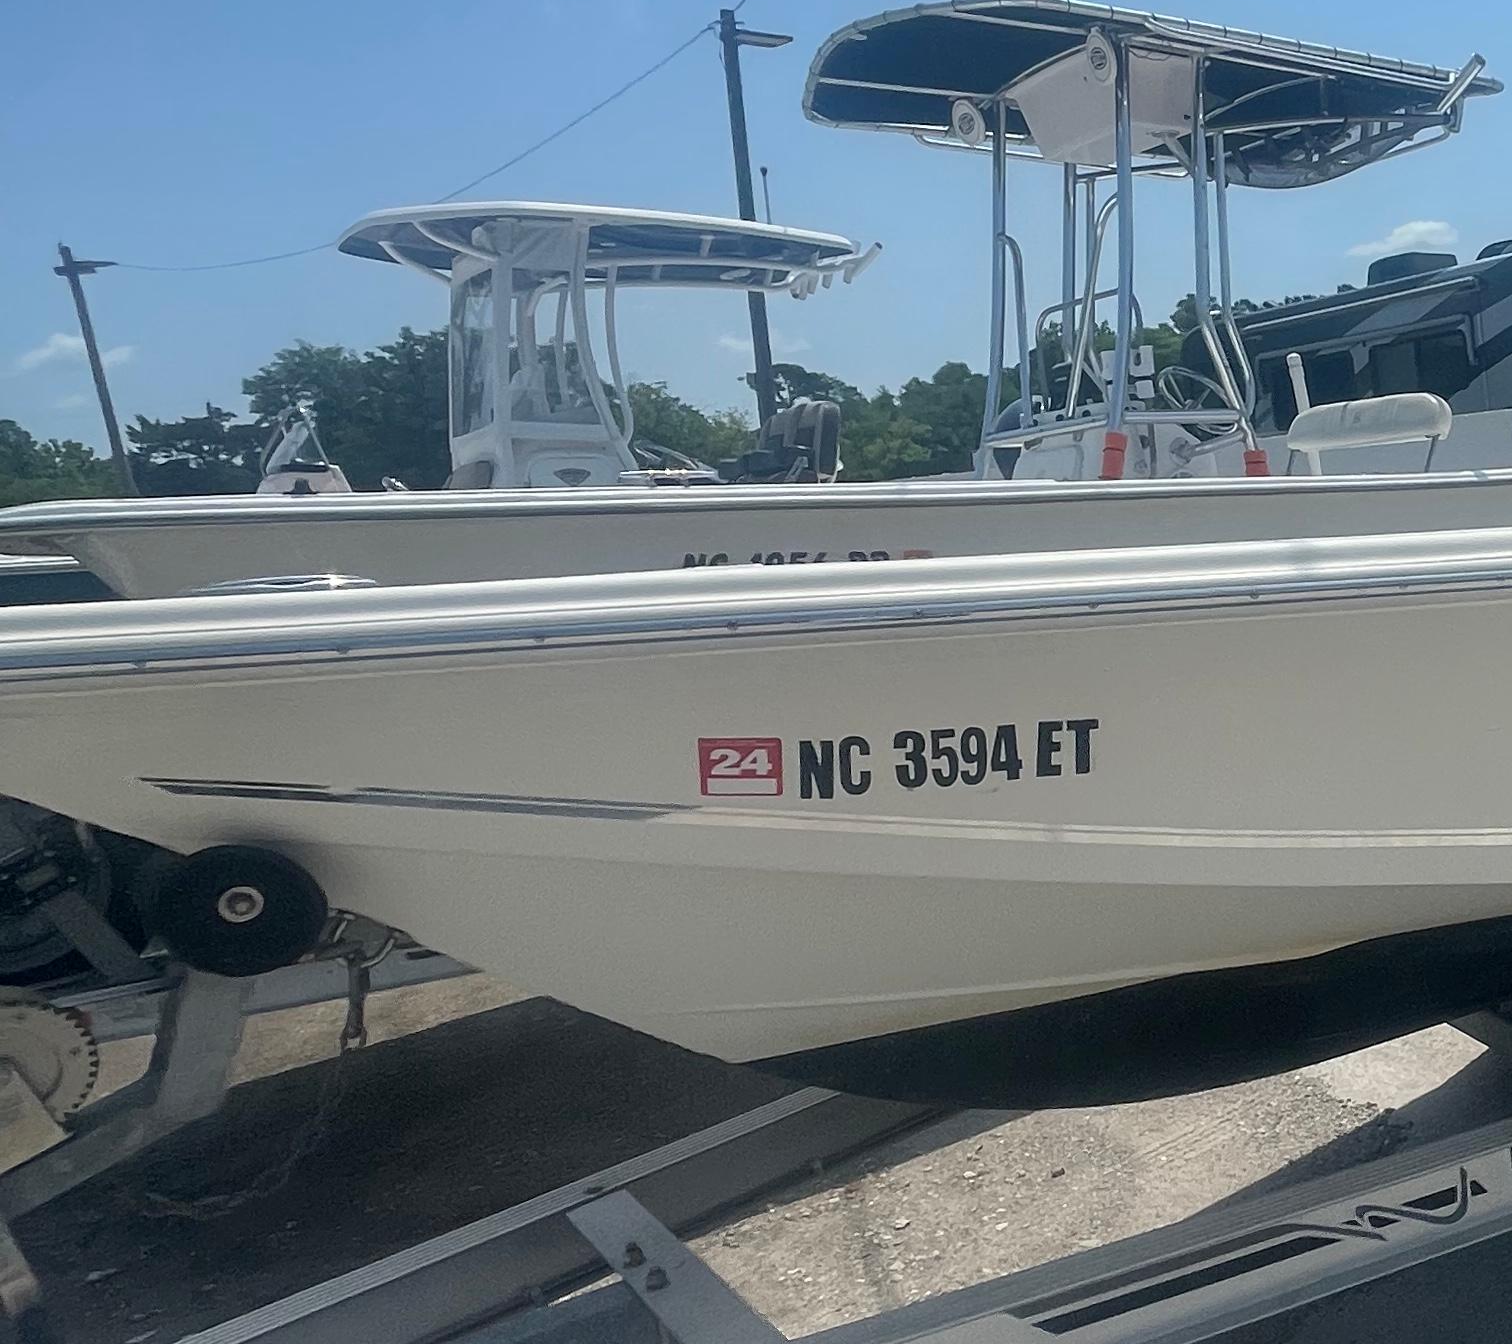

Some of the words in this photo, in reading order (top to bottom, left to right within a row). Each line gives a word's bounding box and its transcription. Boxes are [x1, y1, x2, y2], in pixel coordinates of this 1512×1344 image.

[709, 748, 773, 776] 24
[799, 735, 871, 800] NC
[893, 724, 1023, 789] 3594
[1036, 719, 1099, 777] ET
